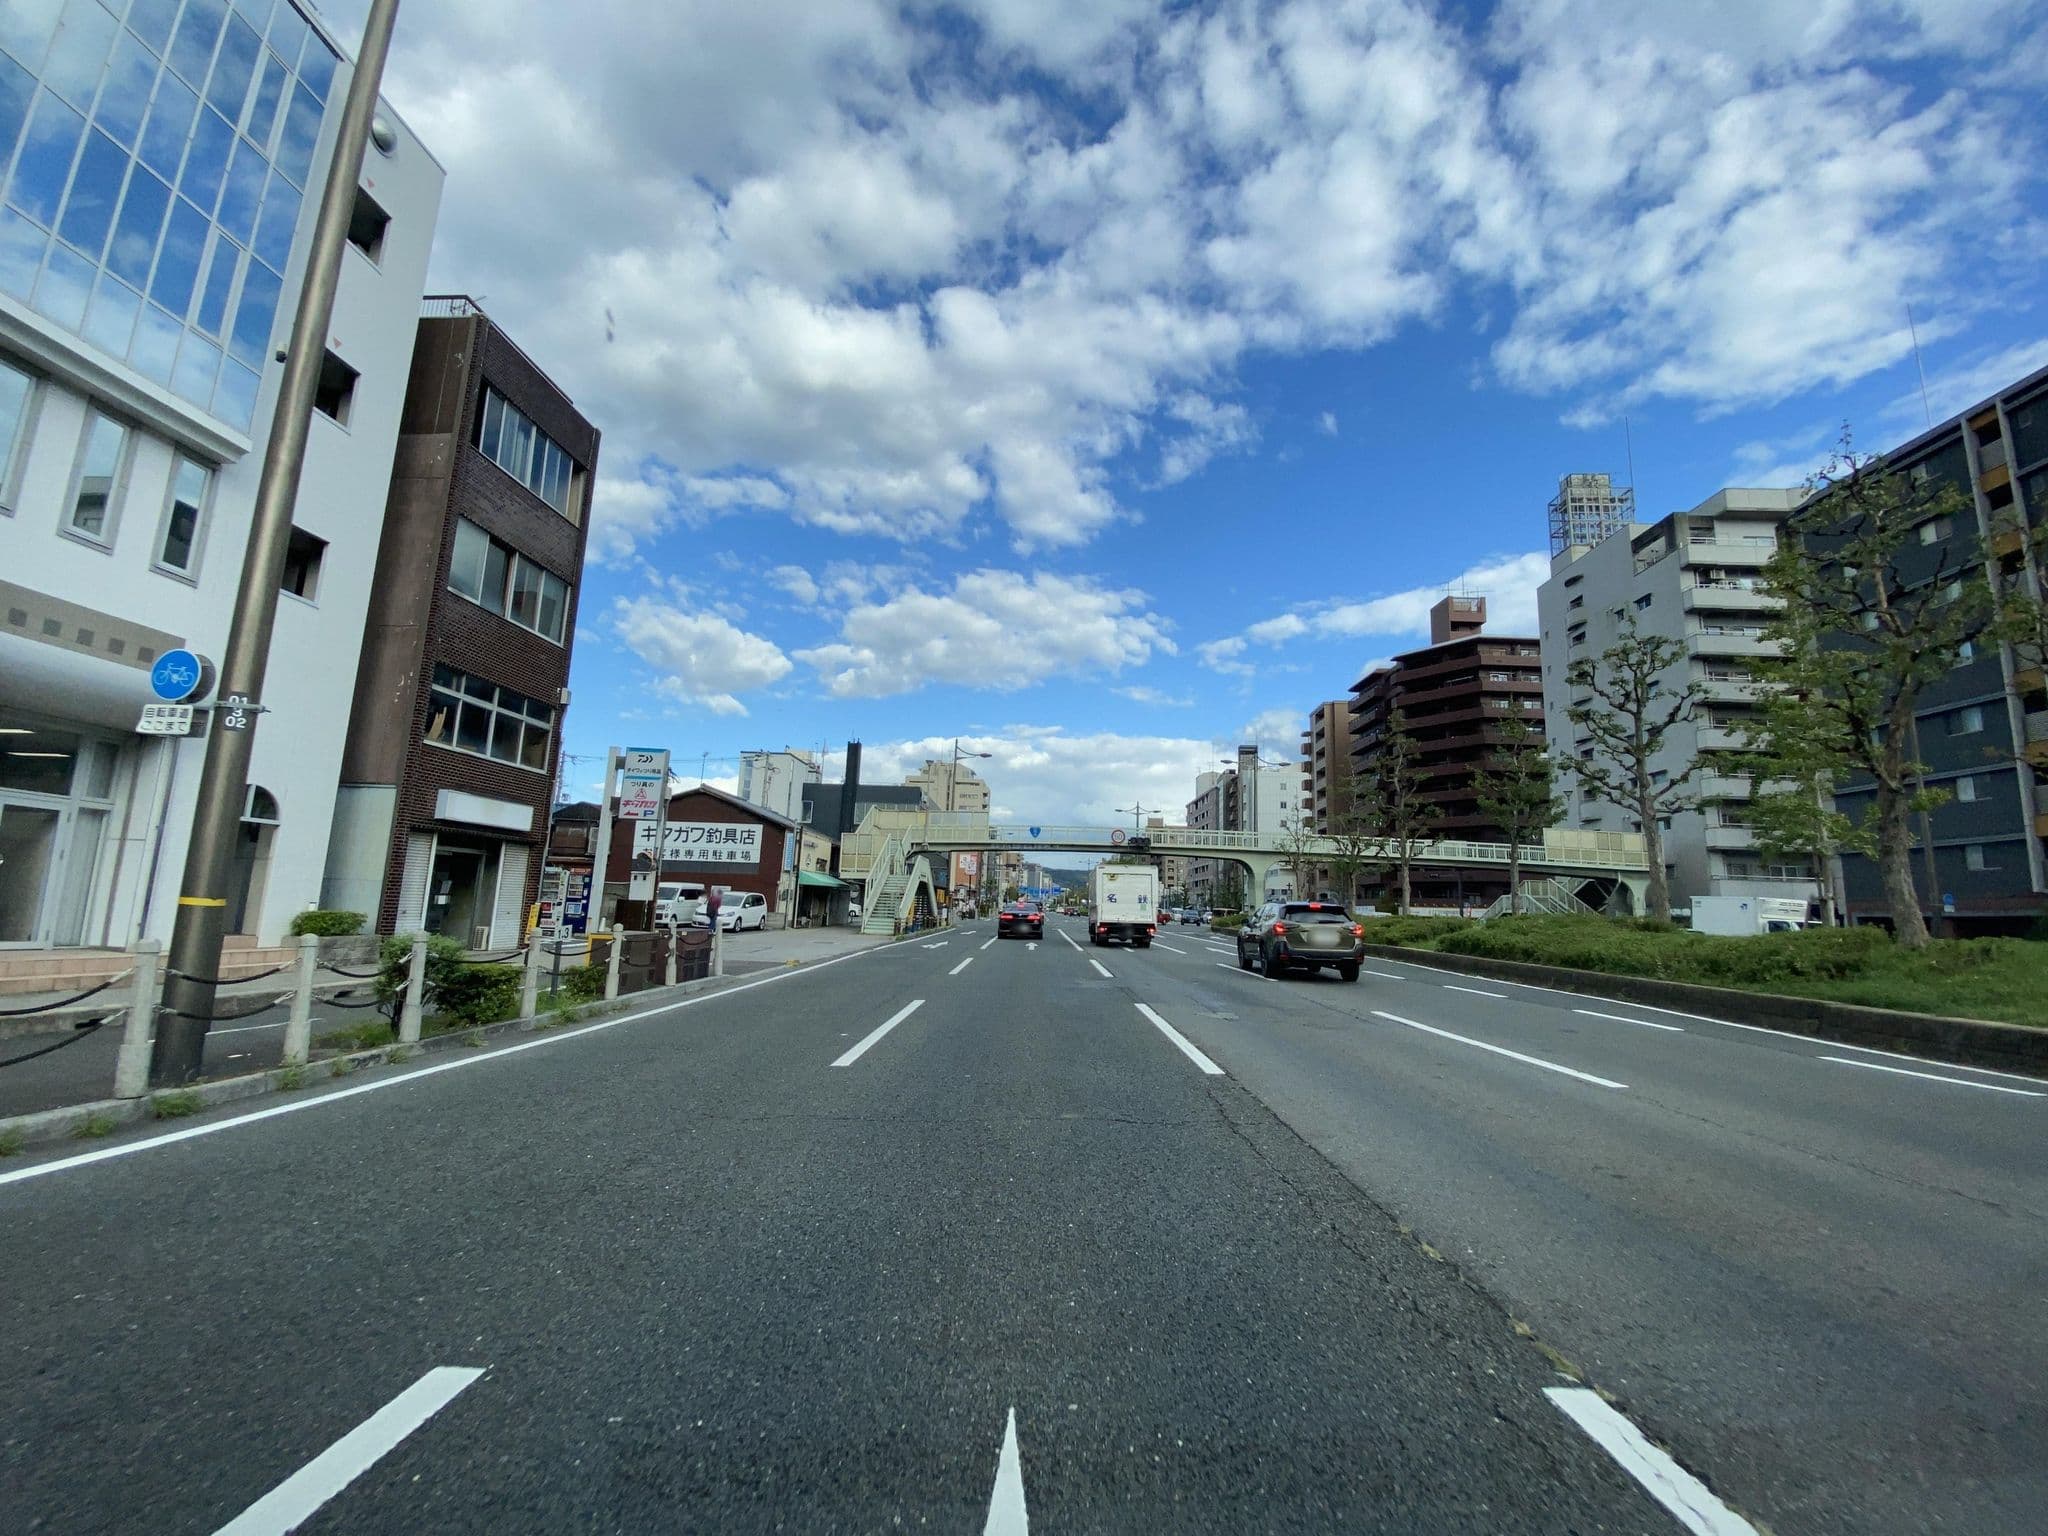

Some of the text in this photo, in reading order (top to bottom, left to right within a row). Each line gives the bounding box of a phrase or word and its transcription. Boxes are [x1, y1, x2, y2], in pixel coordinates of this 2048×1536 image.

[144, 707, 190, 719] 自転車道
[141, 721, 188, 732] ここまで
[225, 717, 246, 729] 02
[643, 848, 752, 861] 様専用駐車場
